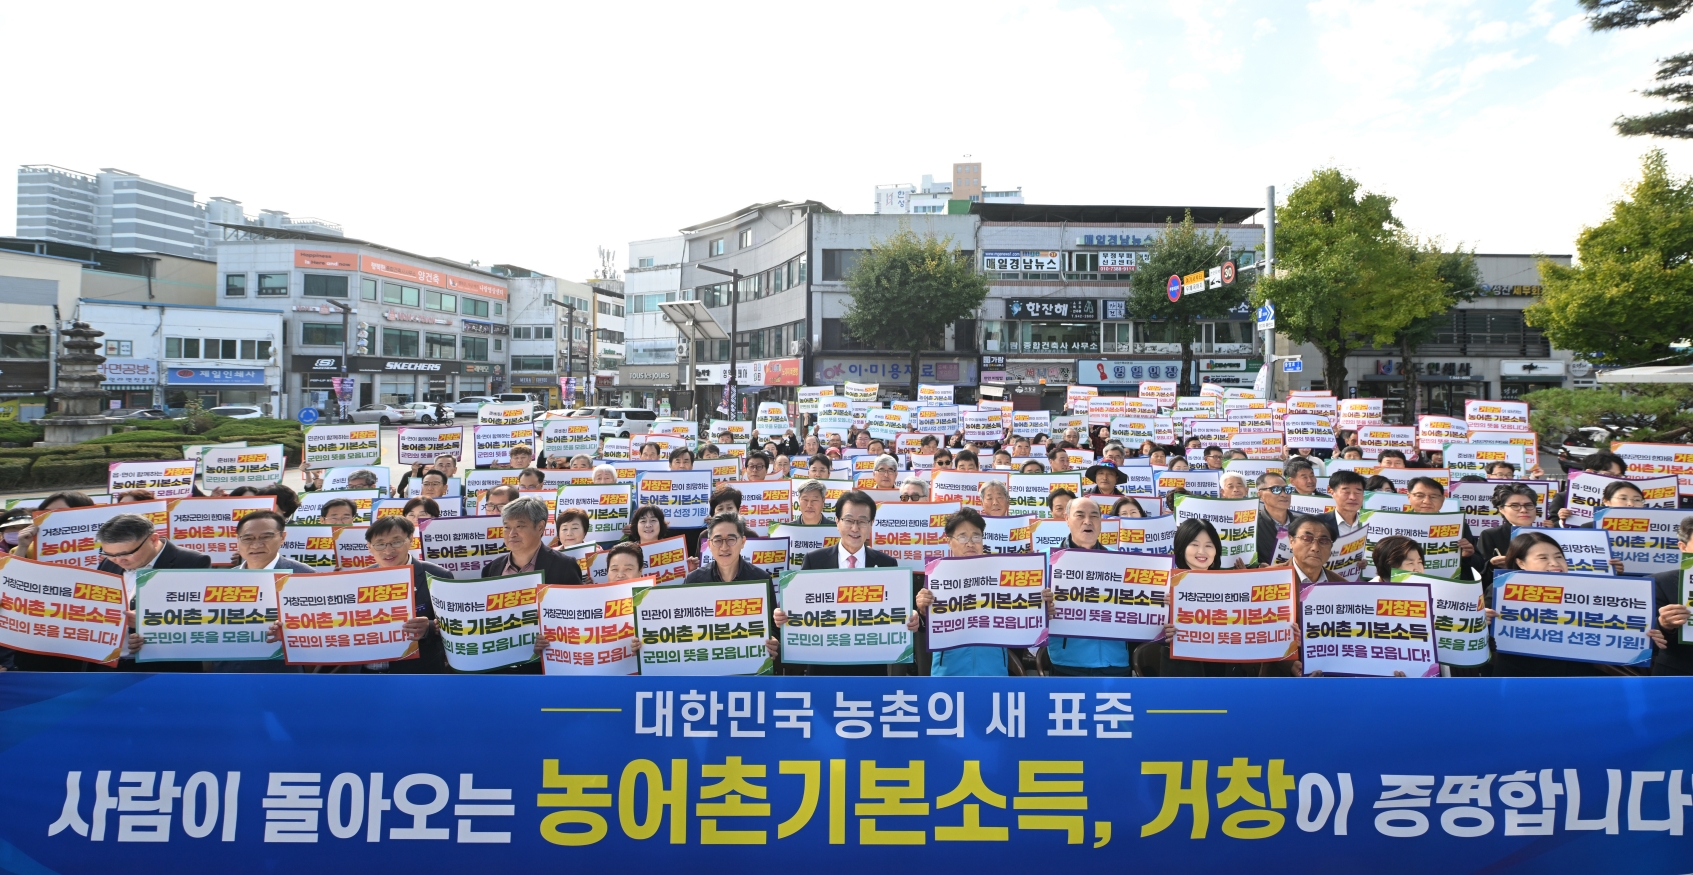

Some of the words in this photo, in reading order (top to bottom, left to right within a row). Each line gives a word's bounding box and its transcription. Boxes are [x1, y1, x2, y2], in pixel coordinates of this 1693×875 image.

[1084, 234, 1154, 246] 매일경남뉴스
[986, 258, 1057, 270] 매일경남뉴스
[417, 270, 439, 285] 양건축
[1224, 267, 1233, 279] 30
[1513, 285, 1544, 296] 세무회
[1026, 301, 1069, 317] 한잔해
[1023, 342, 1068, 350] 종합건축사
[1072, 342, 1098, 350] 사무소
[200, 369, 256, 379] 제일인쇄사
[385, 361, 441, 371] SKECHERS
[823, 362, 846, 379] OK
[1113, 366, 1178, 378] 영일인장
[629, 372, 644, 380] TOUS
[652, 372, 670, 380] JOURS
[1494, 415, 1527, 423] 기본소득
[350, 430, 377, 439] 거창군
[308, 443, 338, 452] 농어촌
[339, 441, 378, 451] 기본소득
[206, 465, 237, 474] 농어촌
[239, 463, 280, 473] 기본소득
[112, 479, 146, 489] 농어촌
[149, 478, 191, 488] 기본소득
[640, 494, 669, 506] 농어촌
[671, 494, 710, 505] 기본소득
[930, 578, 962, 590] 읍·면이
[963, 576, 998, 588] 함께하는
[1001, 570, 1042, 586] 거창군
[1053, 569, 1084, 580] 읍·면이
[1086, 570, 1122, 582] 함께하는
[1124, 568, 1168, 585] 거창군
[2, 576, 41, 594] 거창군민의
[42, 584, 72, 598] 한마음
[75, 582, 122, 603] 거창군
[166, 591, 201, 602] 준비된
[283, 596, 326, 607] 거창군민의
[327, 594, 356, 606] 한마음
[359, 584, 408, 603] 거창군
[805, 593, 834, 603] 준비된
[1054, 585, 1100, 602] 농어촌
[1104, 588, 1165, 607] 기본소득
[1178, 592, 1224, 603] 거창군민의
[1224, 592, 1250, 603] 한마음
[1252, 584, 1290, 601] 거창군
[1, 591, 46, 618] 농어촌
[50, 602, 122, 627] 기본소득
[446, 602, 485, 613] 함께하는
[488, 588, 536, 609] 거창군
[933, 596, 977, 614] 농어촌
[980, 592, 1042, 610] 기본소득
[1304, 605, 1334, 615] 읍·면이
[1336, 604, 1374, 615] 함께하는
[1377, 599, 1426, 617] 거창군
[1437, 599, 1477, 612] 함께하는
[1592, 596, 1647, 610] 희망하는
[144, 608, 202, 626] 농어촌
[284, 612, 333, 630] 농어촌
[338, 606, 408, 627] 기본소득
[543, 608, 575, 619] 거창군민의
[576, 608, 603, 619] 한마음
[641, 608, 672, 620] 민관이
[674, 607, 714, 618] 함께하는
[716, 599, 763, 616] 거창군
[787, 610, 836, 627] 농어촌
[841, 607, 906, 626] 기본소득
[1053, 607, 1087, 621] 군민의
[1089, 609, 1113, 622] 뜻을
[1115, 610, 1165, 626] 모읍니다!
[1177, 608, 1229, 625] 농어촌
[1232, 606, 1291, 625] 기본소득
[469, 609, 538, 636] 기본소득
[932, 618, 965, 633] 군민의
[967, 616, 990, 630] 뜻을
[993, 616, 1043, 629] 모읍니다!
[1500, 605, 1559, 625] 농어촌
[1563, 611, 1647, 633] 기본소득
[0, 615, 30, 634] 군민의
[33, 623, 60, 639] 뜻을
[63, 627, 119, 646] 모읍니다!
[142, 631, 187, 645] 군민의
[190, 631, 219, 644] 뜻을
[543, 625, 581, 644] 농어촌
[642, 625, 693, 644] 농어촌
[697, 621, 765, 640] 기본소득
[787, 633, 823, 647] 군민의
[827, 633, 851, 647] 뜻을
[854, 630, 907, 645] 모읍니다!
[1176, 630, 1215, 644] 군민의
[1217, 630, 1242, 644] 뜻을
[1244, 628, 1291, 643] 모읍니다!
[1306, 621, 1352, 639] 농어촌
[1356, 621, 1428, 642] 기본소득
[1498, 625, 1563, 643] 시범사업
[1567, 633, 1602, 647] 선정
[1605, 635, 1645, 650] 기원!
[288, 636, 322, 648] 군민의
[325, 634, 350, 647] 뜻을
[455, 641, 479, 655] 뜻을
[1438, 637, 1466, 651] 뜻을
[546, 649, 571, 663] 군민의
[573, 652, 594, 666] 뜻을
[643, 650, 680, 663] 군민의
[683, 648, 709, 662] 뜻을
[712, 645, 767, 661] 모읍니다!
[1306, 645, 1339, 659] 군민의
[1342, 644, 1367, 658] 뜻을
[1371, 646, 1431, 662] 모읍니다!
[636, 690, 813, 738] 대한민국
[834, 690, 964, 738] 농촌의
[987, 691, 1025, 738] 새
[1048, 692, 1133, 738] 표준
[48, 770, 240, 842] 사람이
[263, 772, 515, 843] 돌아오는
[1141, 757, 1353, 840] 거창이
